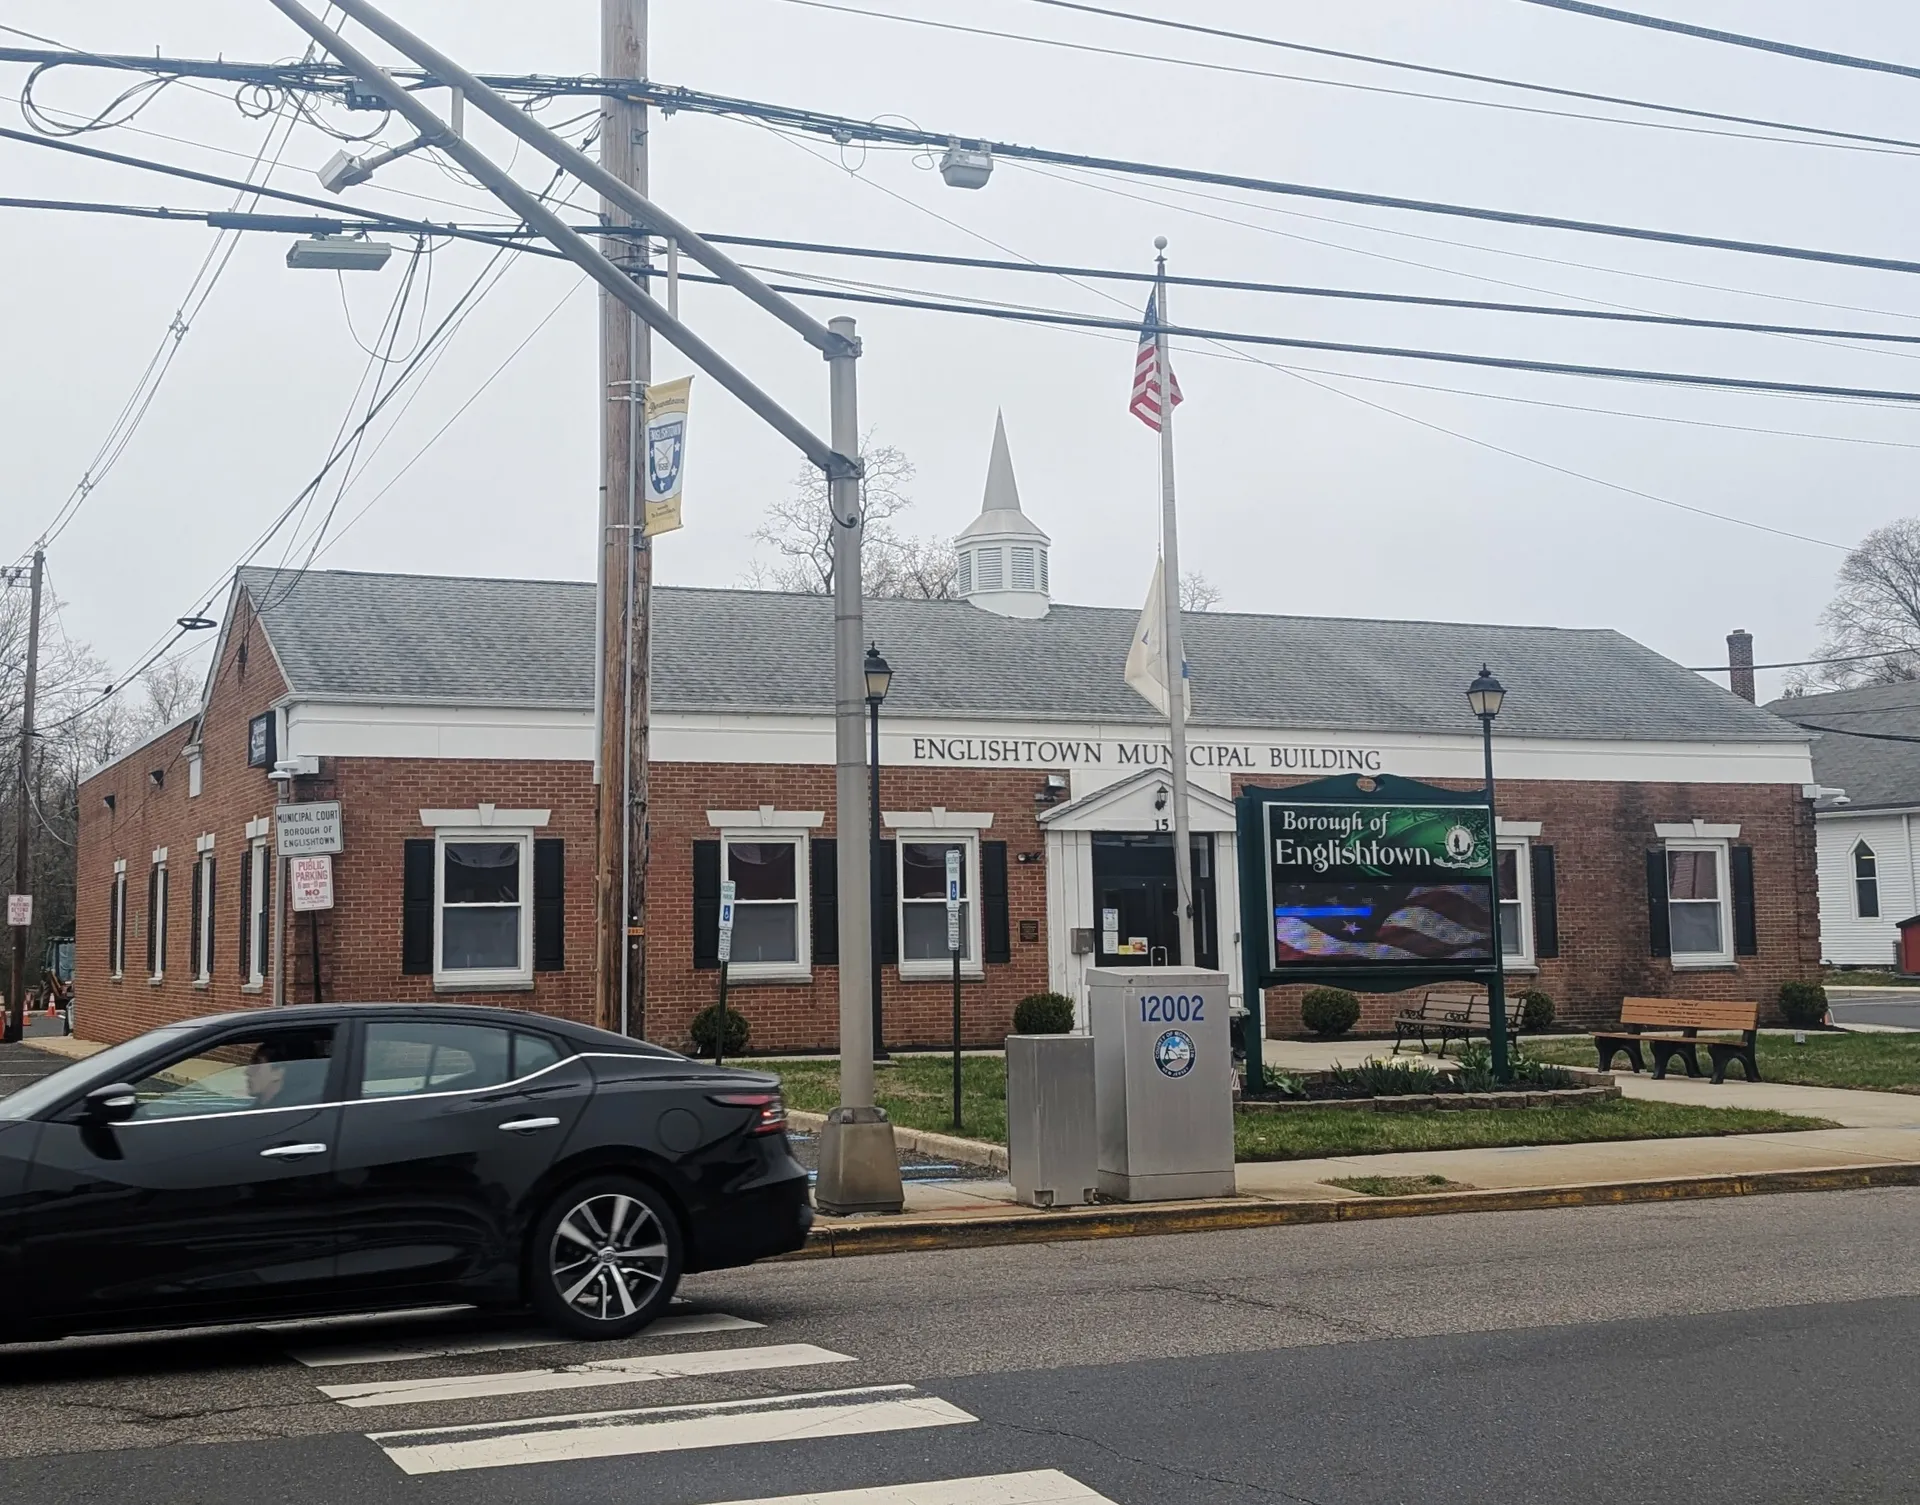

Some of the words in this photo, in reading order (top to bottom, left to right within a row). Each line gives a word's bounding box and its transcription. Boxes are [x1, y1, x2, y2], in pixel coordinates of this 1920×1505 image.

[913, 738, 1102, 764] ENGLISHTOWN
[1270, 747, 1381, 770] BUILDING
[277, 811, 313, 823] MUNICIPAL
[316, 809, 338, 821] COURT
[284, 827, 320, 837] BOROUGH
[323, 825, 333, 834] OF
[1155, 818, 1169, 832] 15
[1282, 810, 1364, 839] Borough
[1370, 811, 1391, 838] of
[283, 837, 336, 848] ENGLISHTOWN
[1275, 838, 1431, 873] Englishtown
[298, 860, 325, 871] PUBLIC
[295, 870, 328, 882] PARKING
[1140, 995, 1205, 1022] 12002
[1155, 1035, 1166, 1059] COUNTY
[1174, 1031, 1195, 1058] MONMOUTH
